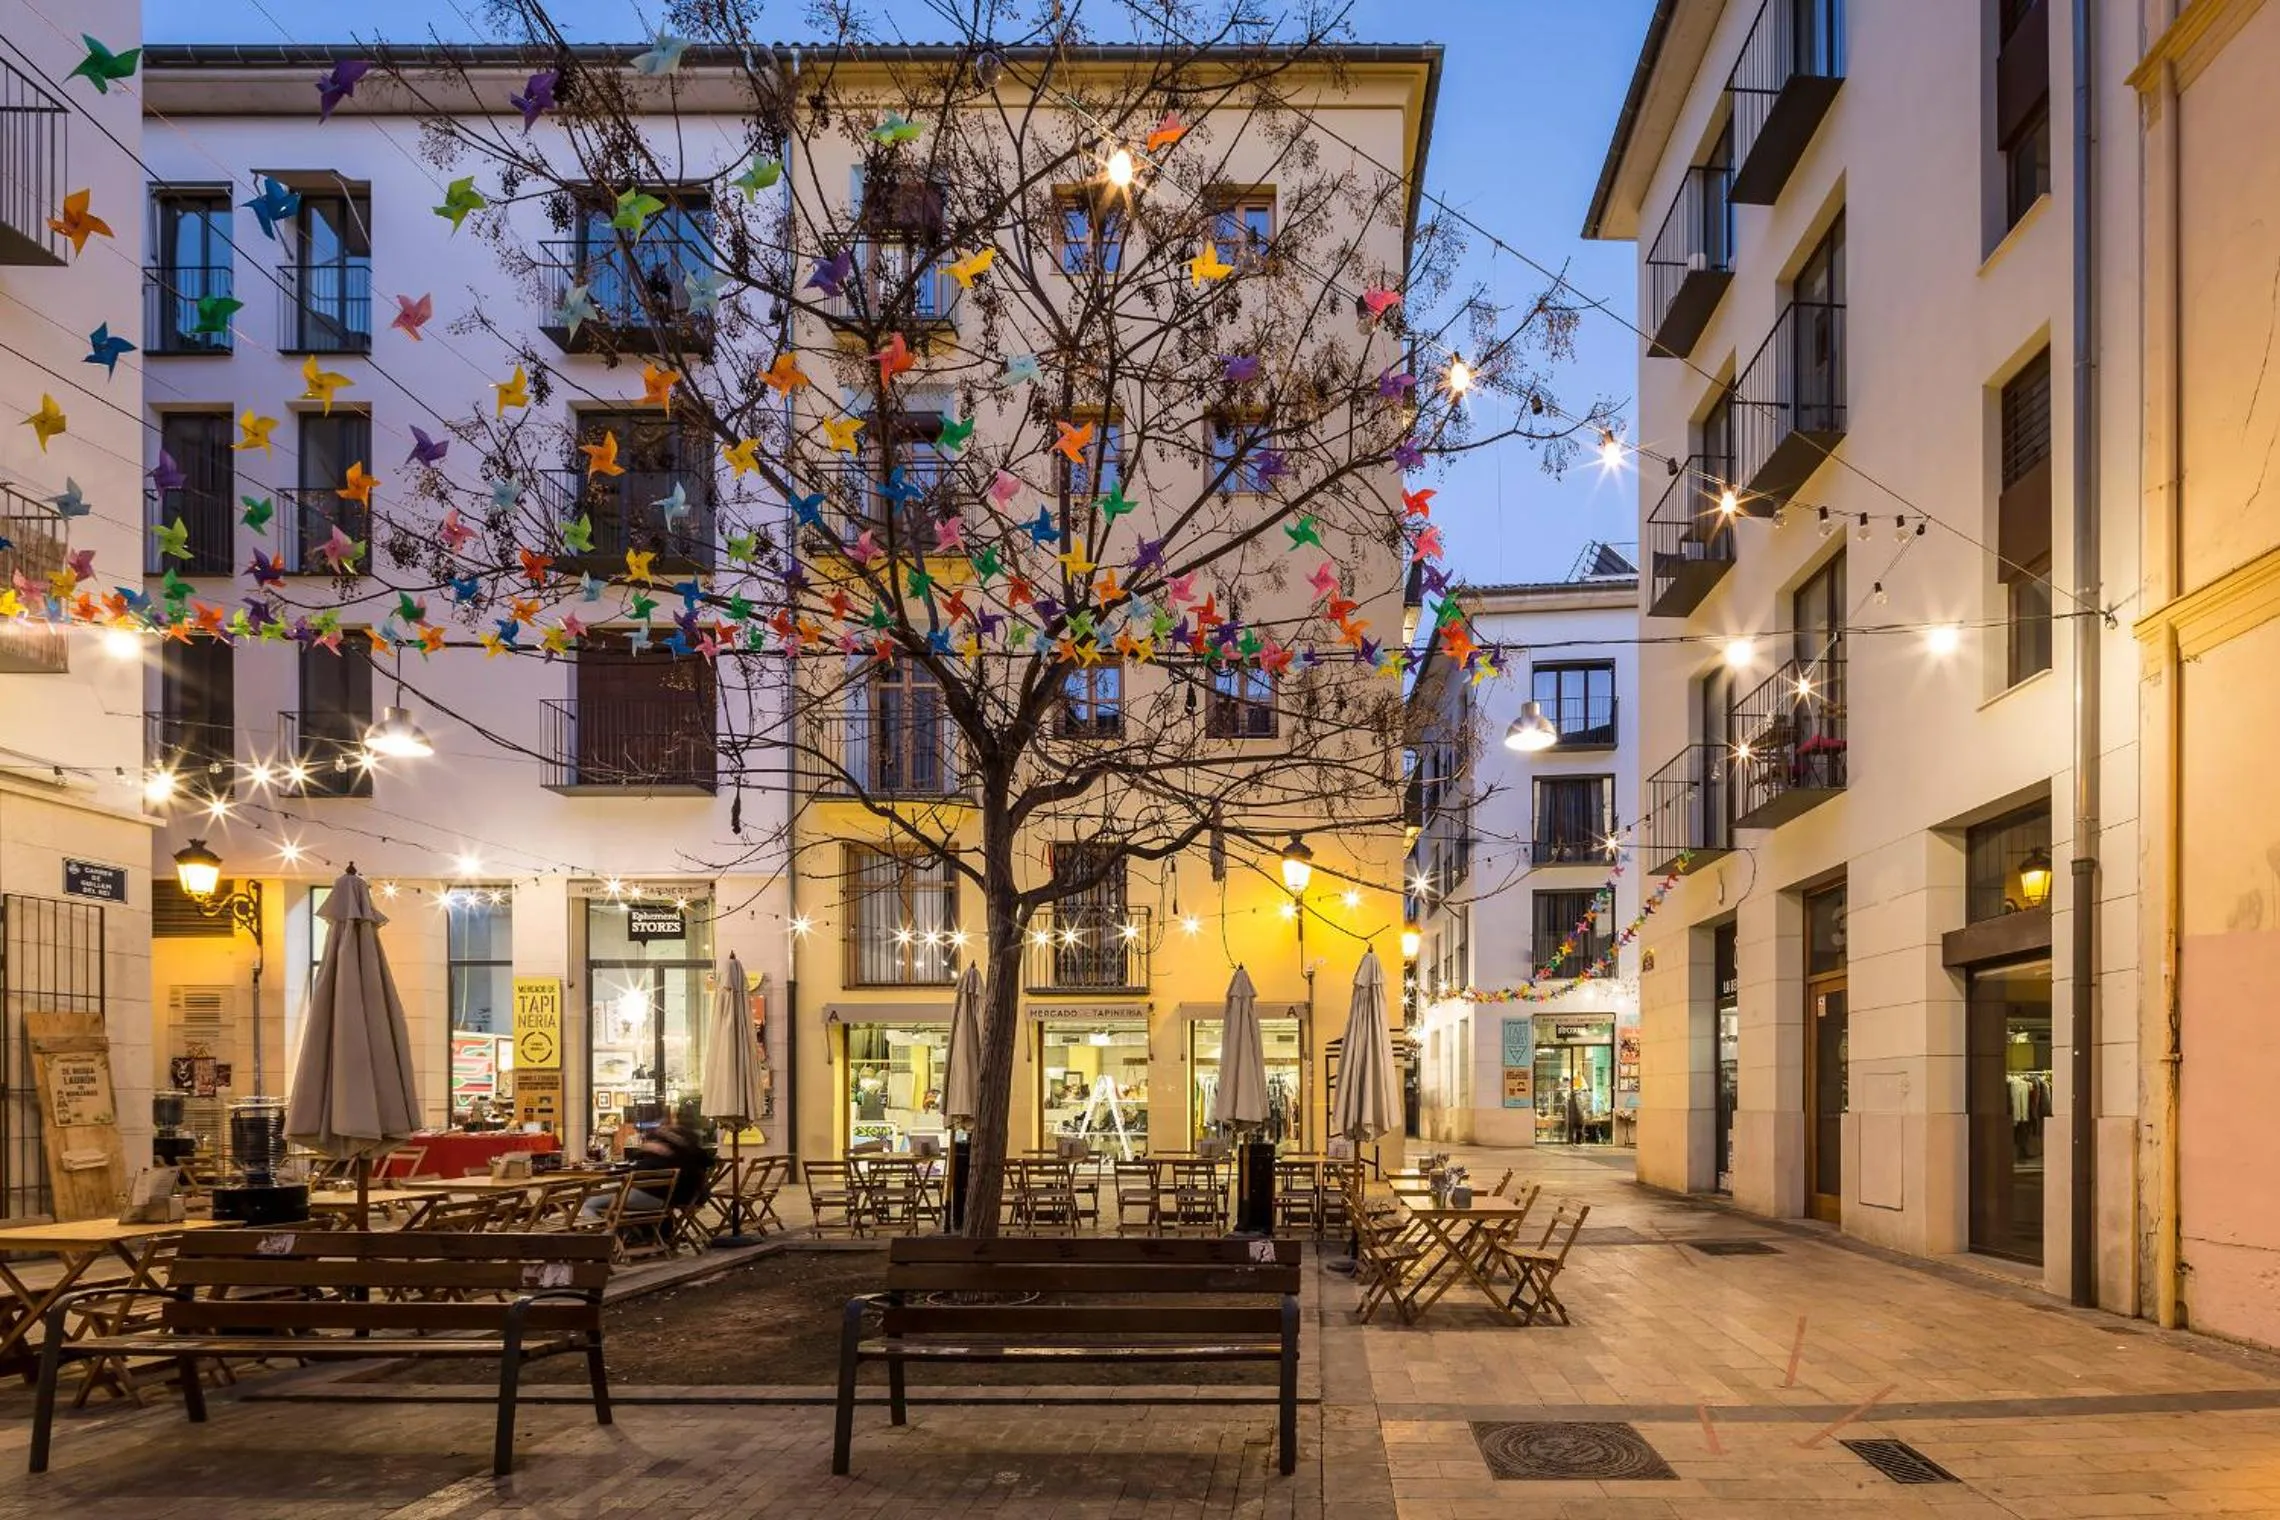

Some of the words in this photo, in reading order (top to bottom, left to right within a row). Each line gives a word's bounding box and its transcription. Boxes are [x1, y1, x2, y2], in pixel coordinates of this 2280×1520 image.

[632, 911, 681, 922] Ephemeral
[632, 922, 681, 933] STORES
[518, 995, 555, 1014] TAPI
[1030, 1009, 1078, 1018] MERCADO
[1093, 1008, 1143, 1018] TAPINERIA
[517, 1014, 557, 1029] NERIA
